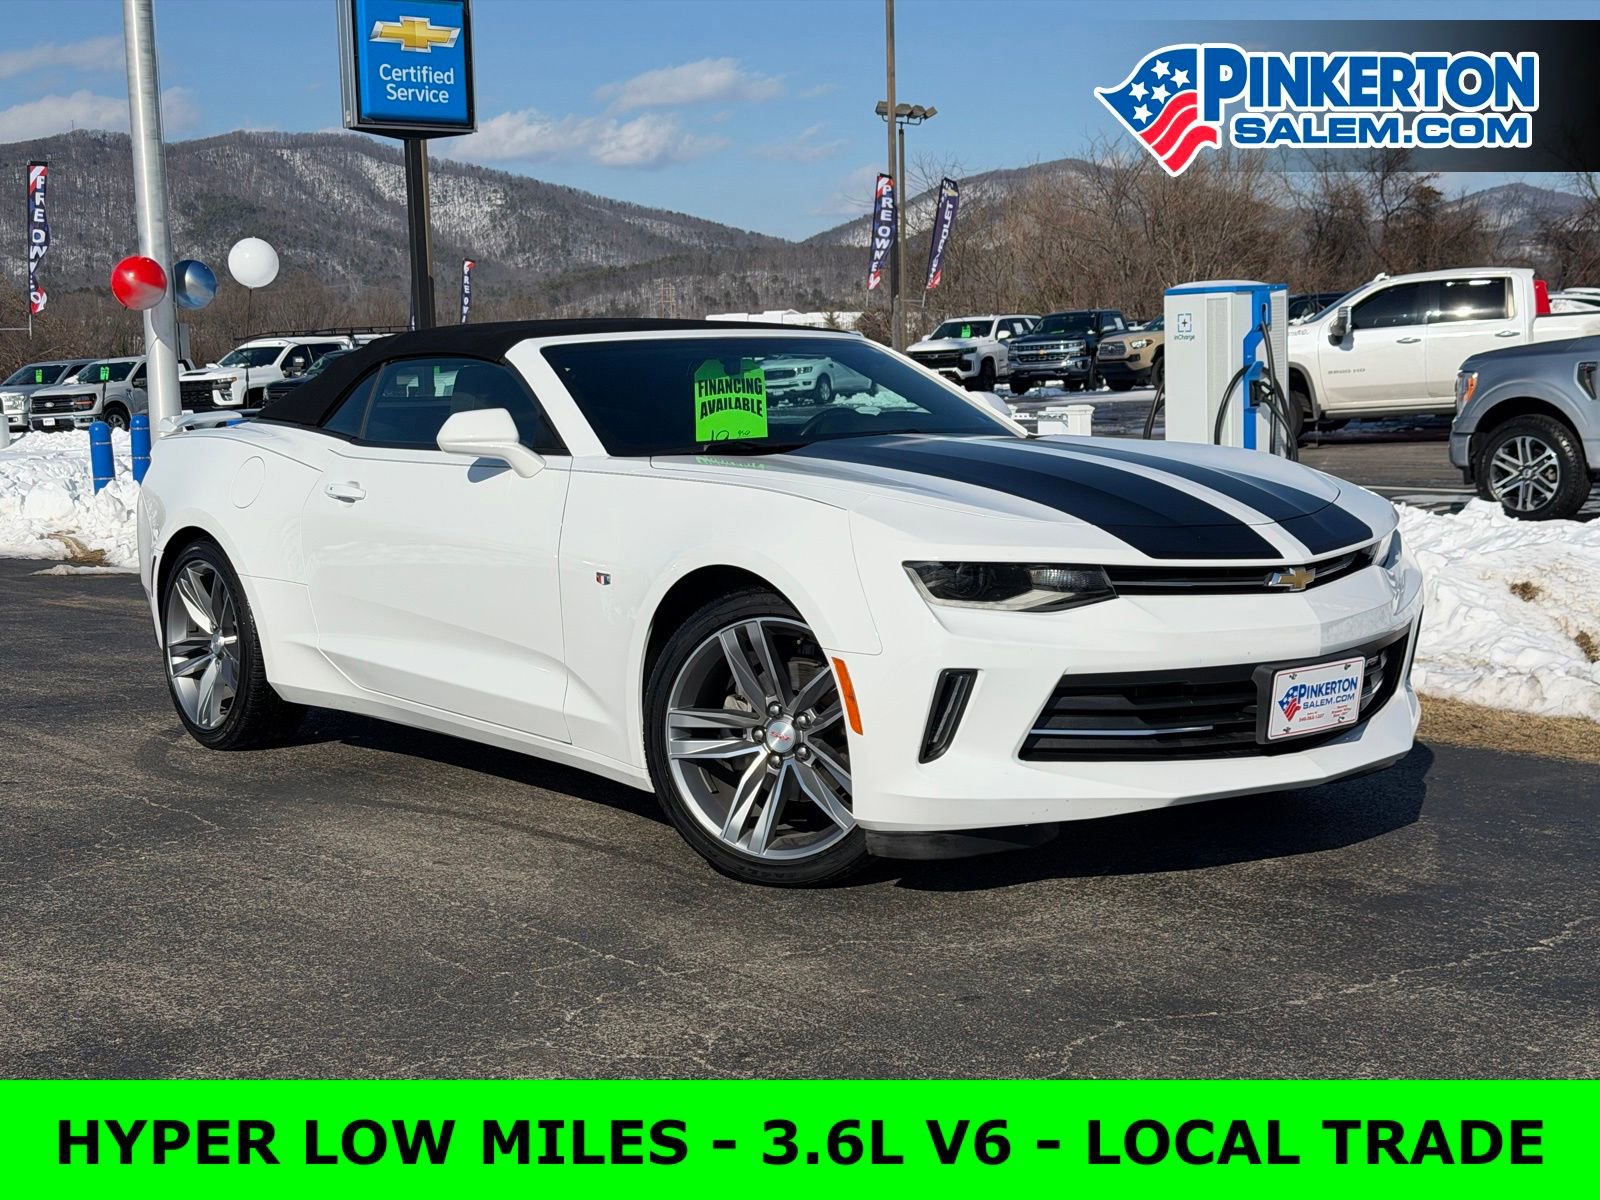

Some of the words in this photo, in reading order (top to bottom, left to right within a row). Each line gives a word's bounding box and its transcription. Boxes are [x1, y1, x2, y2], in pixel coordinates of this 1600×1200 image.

[379, 63, 455, 85] Certified
[386, 83, 449, 104] Service
[881, 184, 893, 222] PRE
[698, 377, 763, 398] FINANCING
[700, 396, 764, 420] AVAILABLE
[1297, 676, 1359, 705] PINKERTON
[1302, 692, 1355, 710] SALEM.COM
